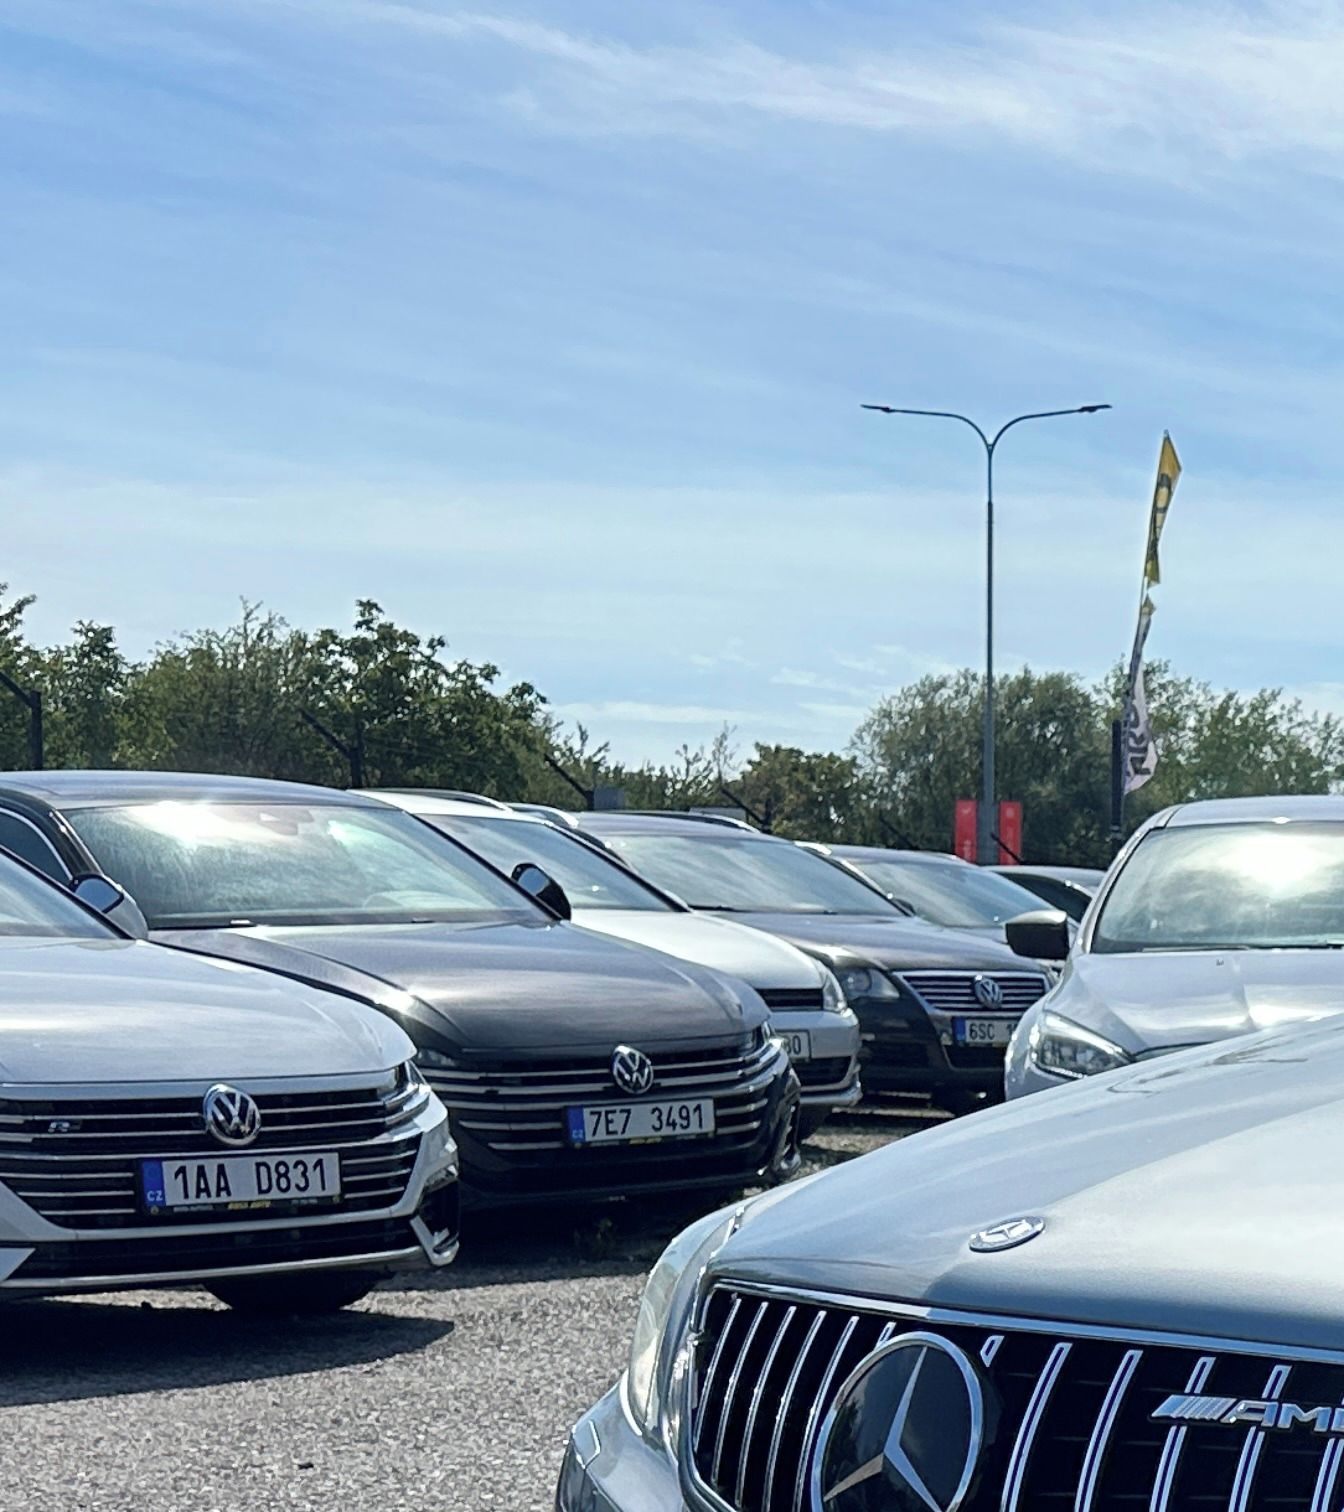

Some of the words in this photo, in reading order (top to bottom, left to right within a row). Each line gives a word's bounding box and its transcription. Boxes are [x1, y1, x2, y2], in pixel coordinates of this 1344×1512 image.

[589, 1108, 632, 1138] 7E7
[651, 1103, 704, 1132] 3491
[147, 1191, 164, 1202] CZ
[174, 1163, 232, 1200] 1AA
[255, 1158, 327, 1196] D831
